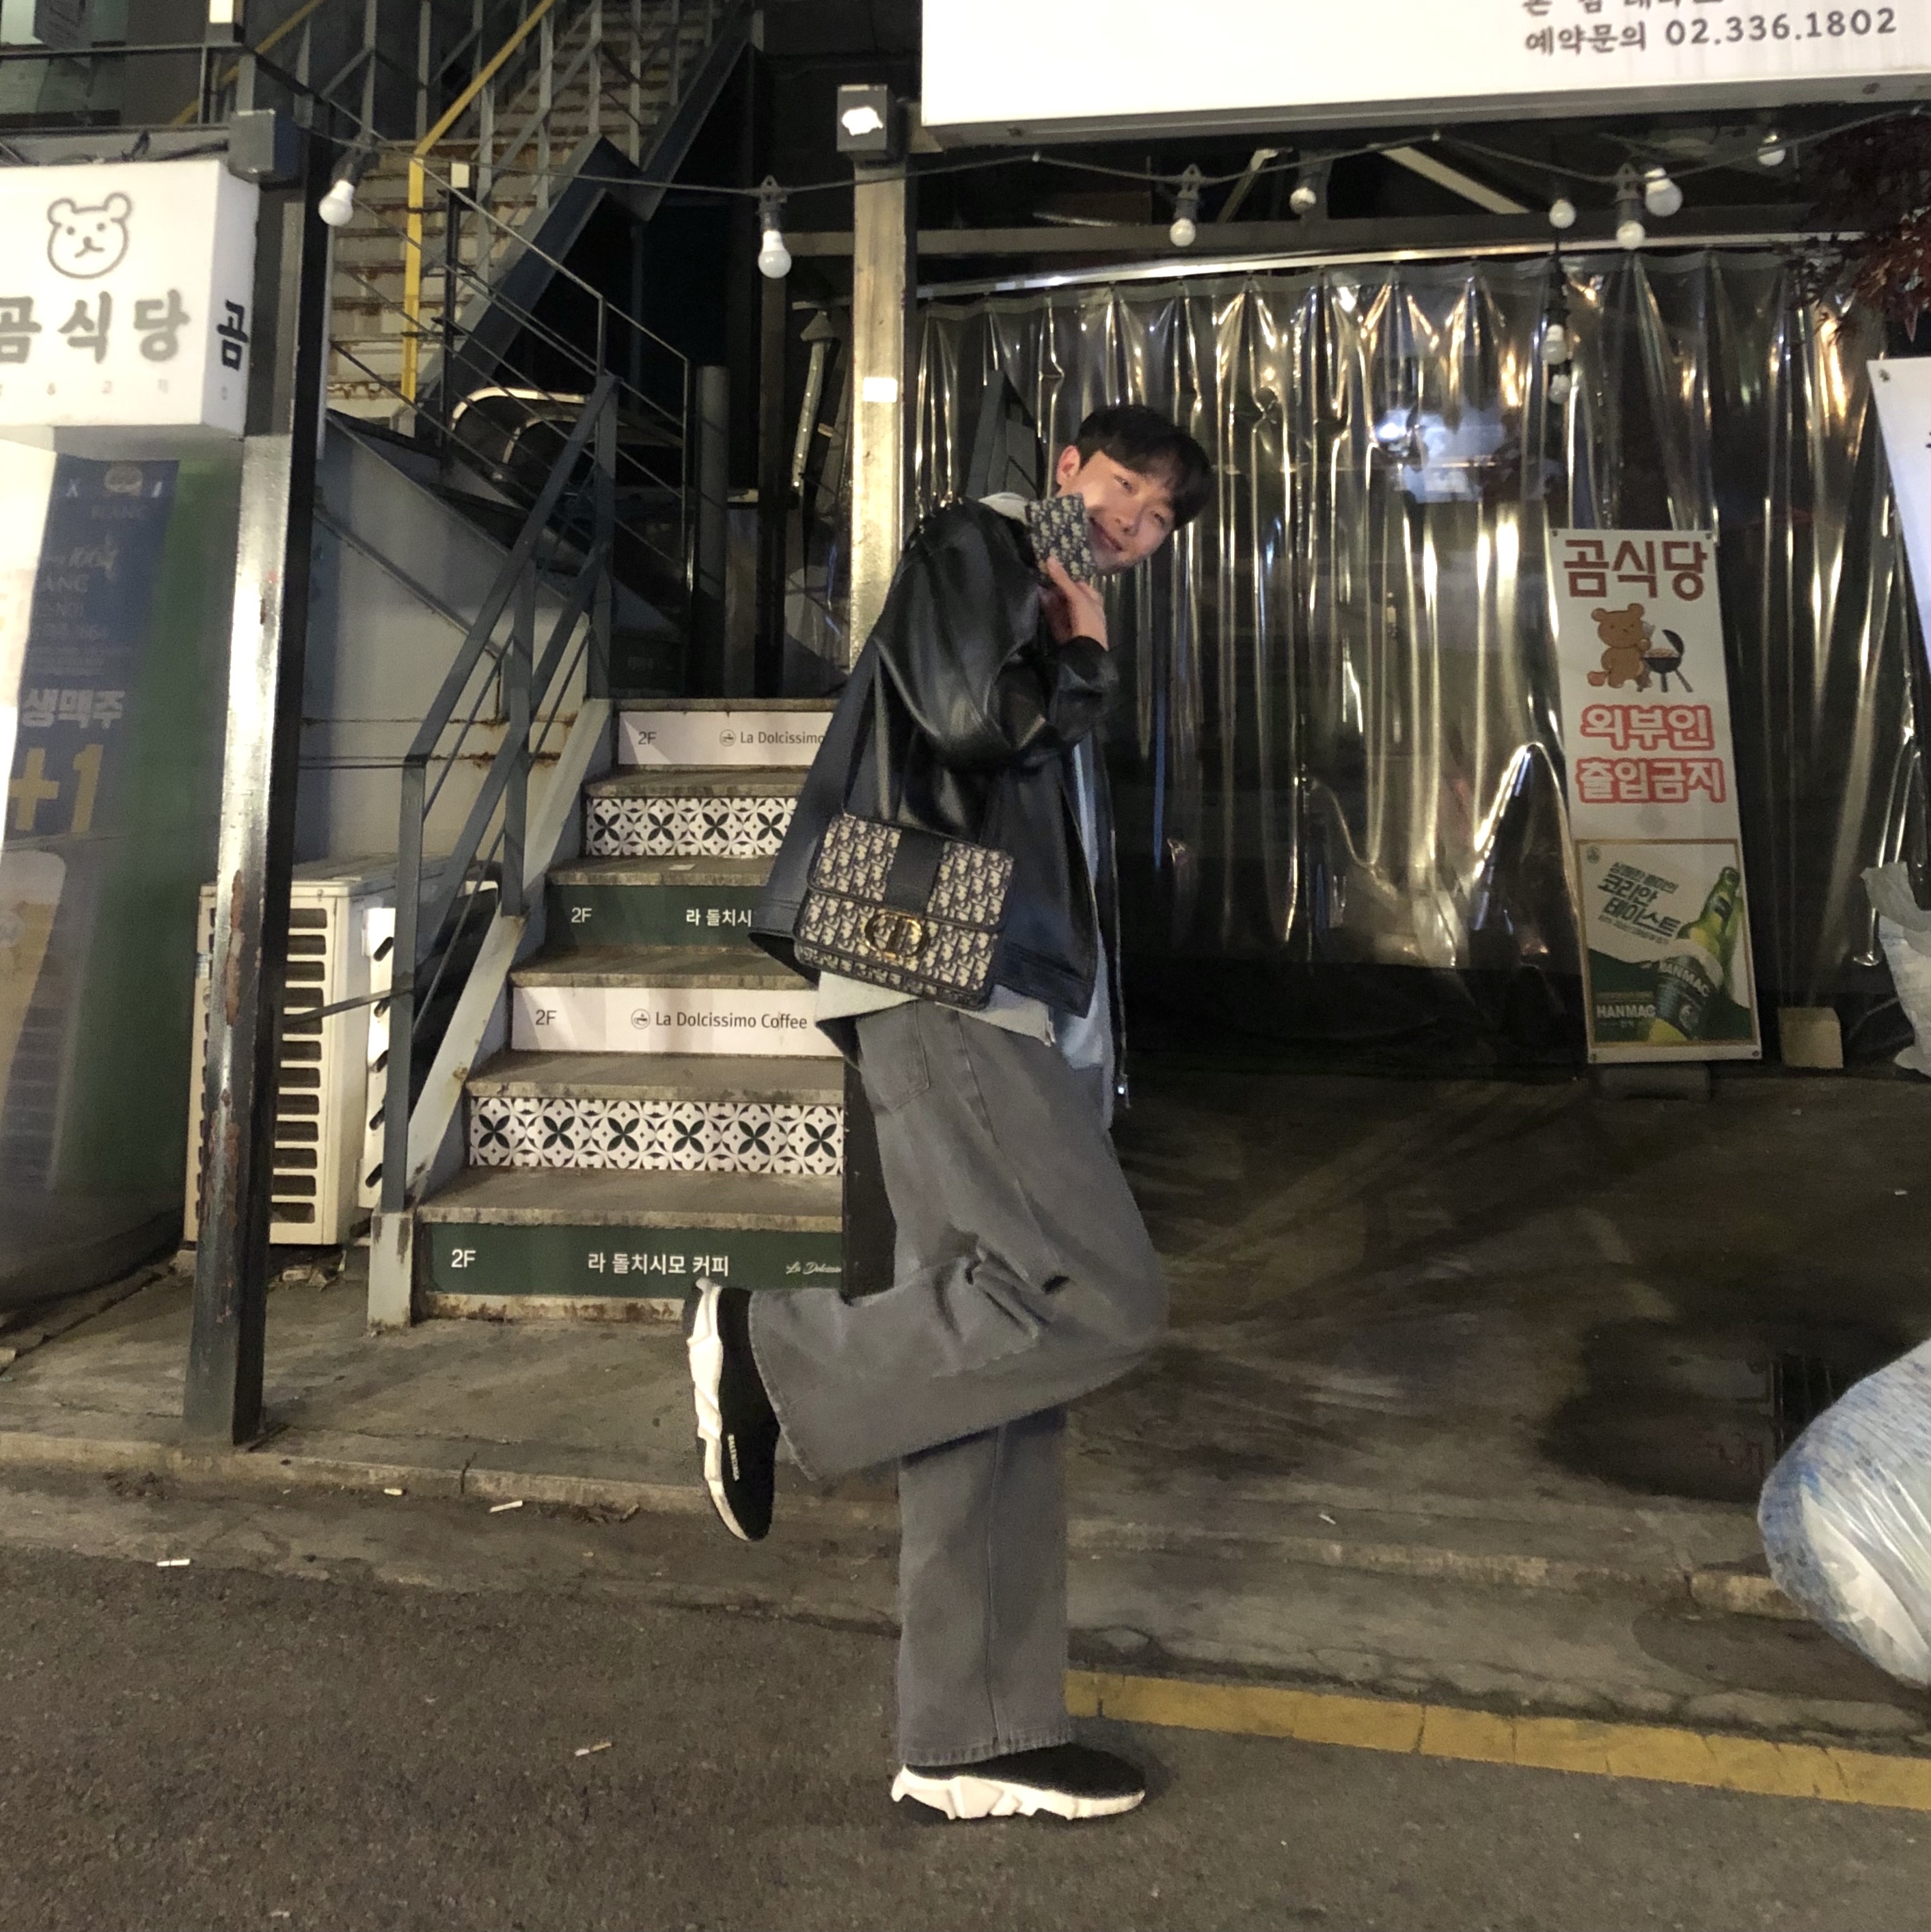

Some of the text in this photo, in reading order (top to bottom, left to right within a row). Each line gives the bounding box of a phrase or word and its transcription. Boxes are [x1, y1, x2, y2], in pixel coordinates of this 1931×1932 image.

[1524, 20, 1647, 57] 예약문의
[1665, 7, 1898, 47] 02.336.1802
[217, 299, 249, 371] 곰
[1563, 539, 1708, 601] 곰식당
[21, 688, 126, 729] 생맥주
[638, 731, 657, 745] 2F
[740, 731, 824, 744] La Dolcissimo
[1580, 704, 1715, 751] 외부인
[1576, 757, 1727, 804] 출입금지
[1598, 873, 1658, 908] 코리안
[571, 908, 592, 923] 2F
[685, 908, 701, 926] 라
[1603, 897, 1682, 937] 테이스트
[535, 1009, 557, 1026] 2F
[655, 1011, 808, 1029] La Dolcissimo Coffee
[1596, 1003, 1656, 1019] HANMAC
[451, 1249, 476, 1268] 2F
[587, 1252, 730, 1277] 라 돌치시모 커피
